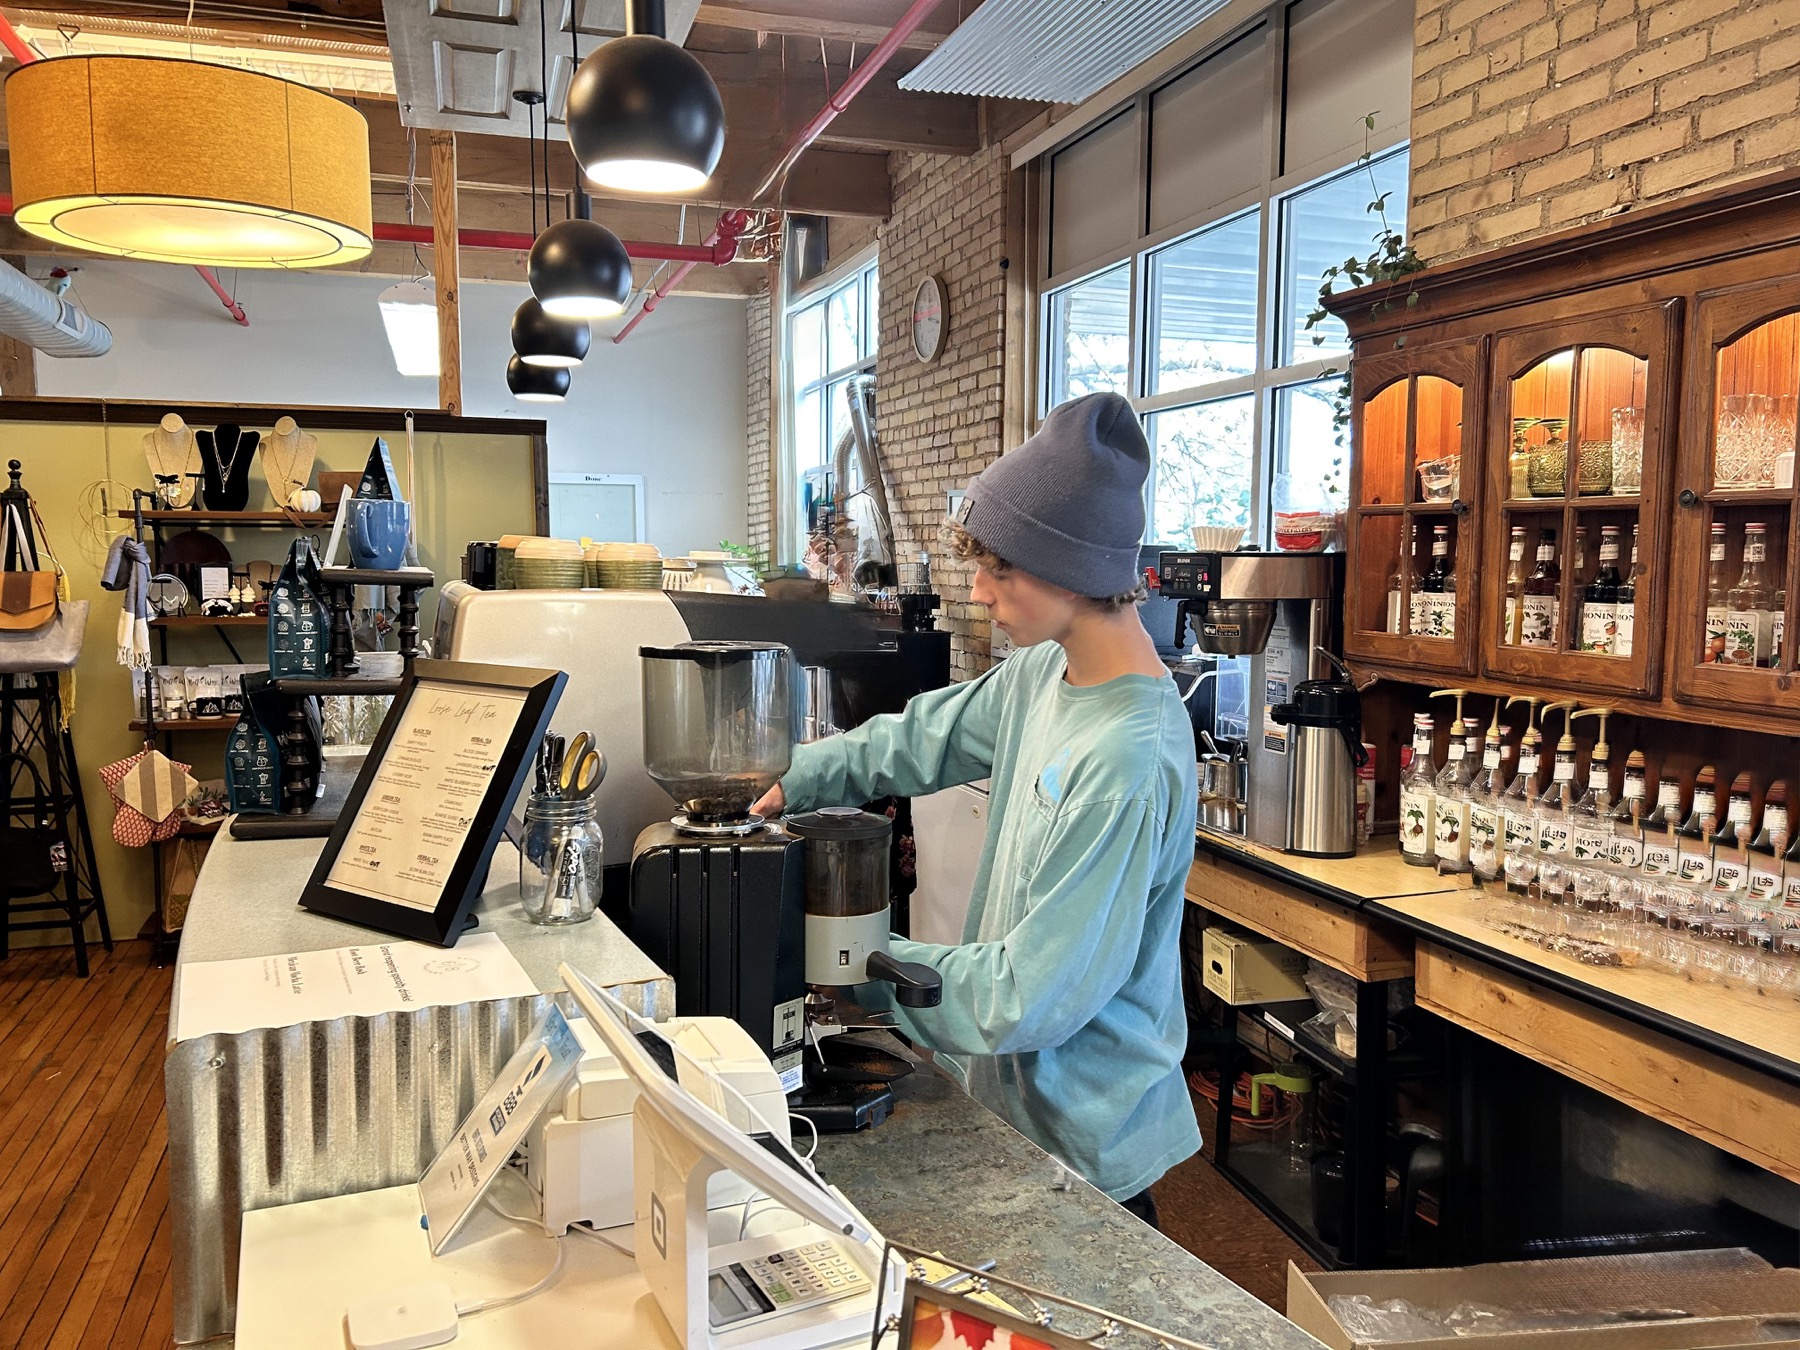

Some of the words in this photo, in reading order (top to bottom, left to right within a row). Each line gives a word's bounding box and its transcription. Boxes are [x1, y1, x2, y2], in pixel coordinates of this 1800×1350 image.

[454, 701, 480, 724] Leaf
[480, 704, 496, 720] Tea
[481, 763, 495, 771] OUT
[566, 842, 580, 874] EXPO
[379, 945, 393, 956] Grand
[384, 955, 398, 974] reopening
[391, 970, 406, 990] specialty
[503, 1091, 517, 1115] BBB
[460, 1132, 470, 1153] BETTER
[468, 1162, 479, 1187] DESIGNS
